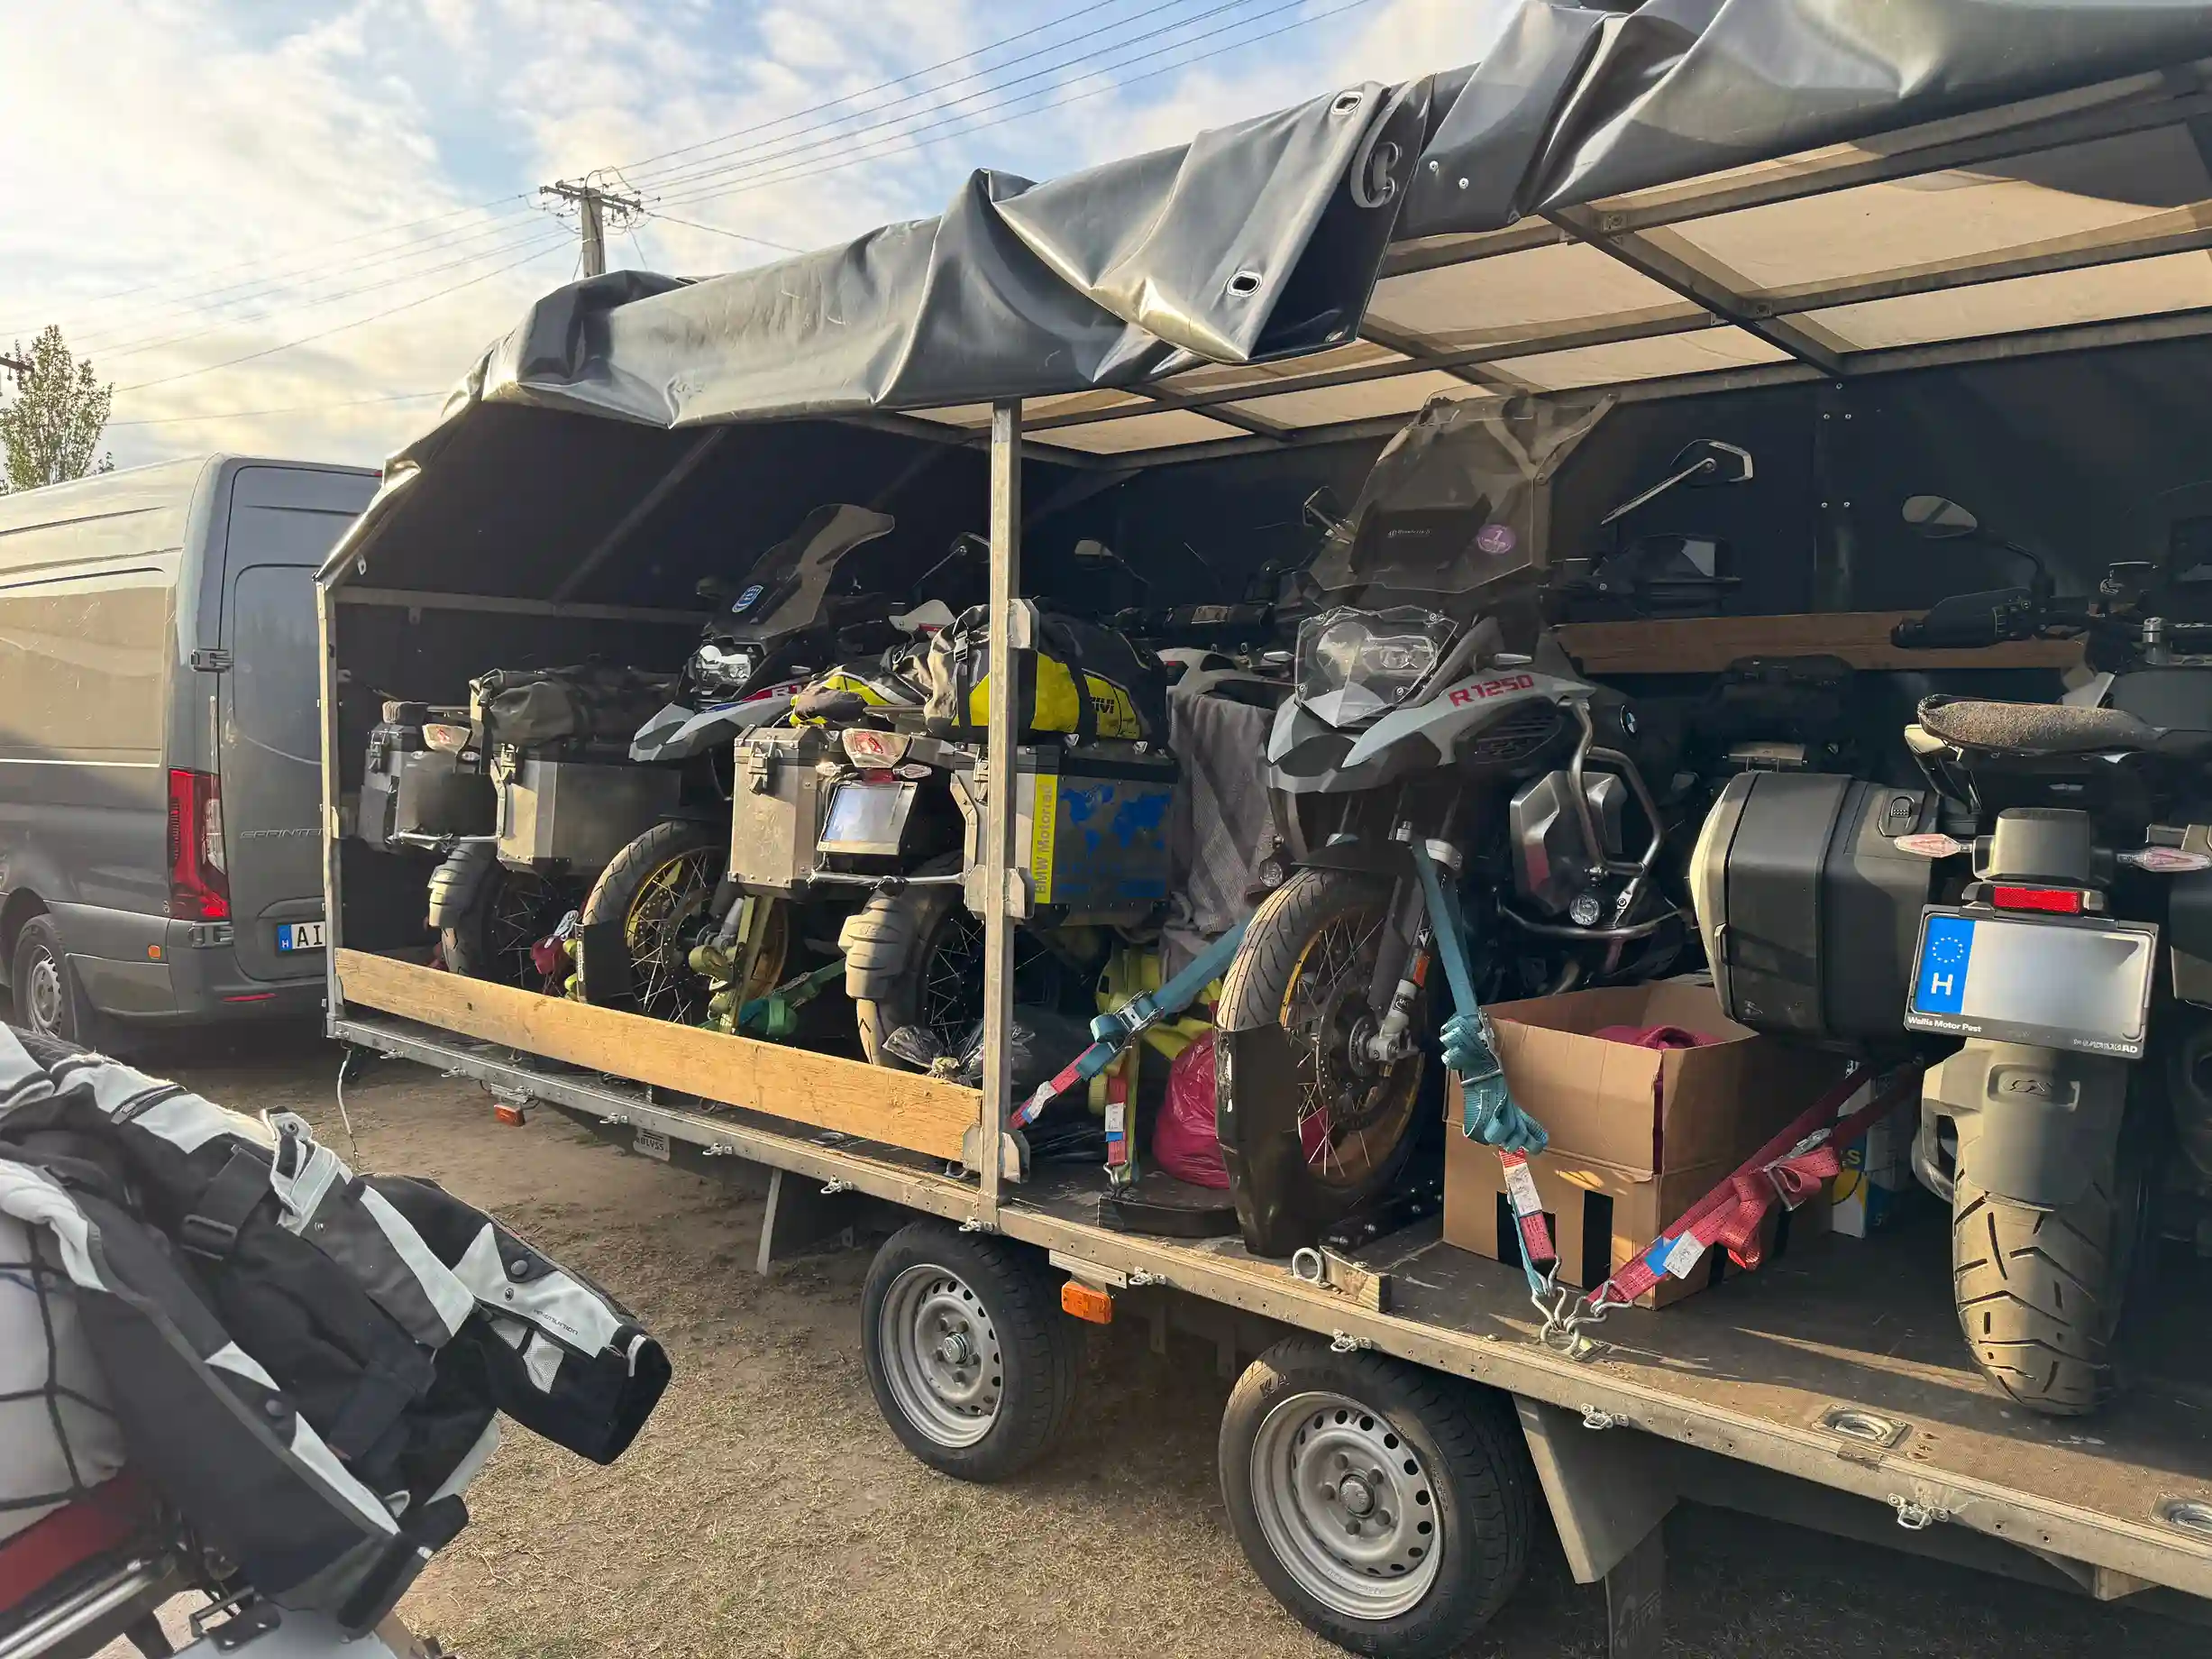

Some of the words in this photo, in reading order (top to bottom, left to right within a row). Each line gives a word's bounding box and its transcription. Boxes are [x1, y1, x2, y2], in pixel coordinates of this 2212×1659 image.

[1037, 784, 1053, 853] Motorrad
[240, 828, 323, 839] SPRINTE
[1035, 856, 1049, 894] BMW
[1931, 973, 1953, 995] H
[1907, 1015, 1933, 1027] Wallis
[1934, 1020, 1961, 1031] Motor
